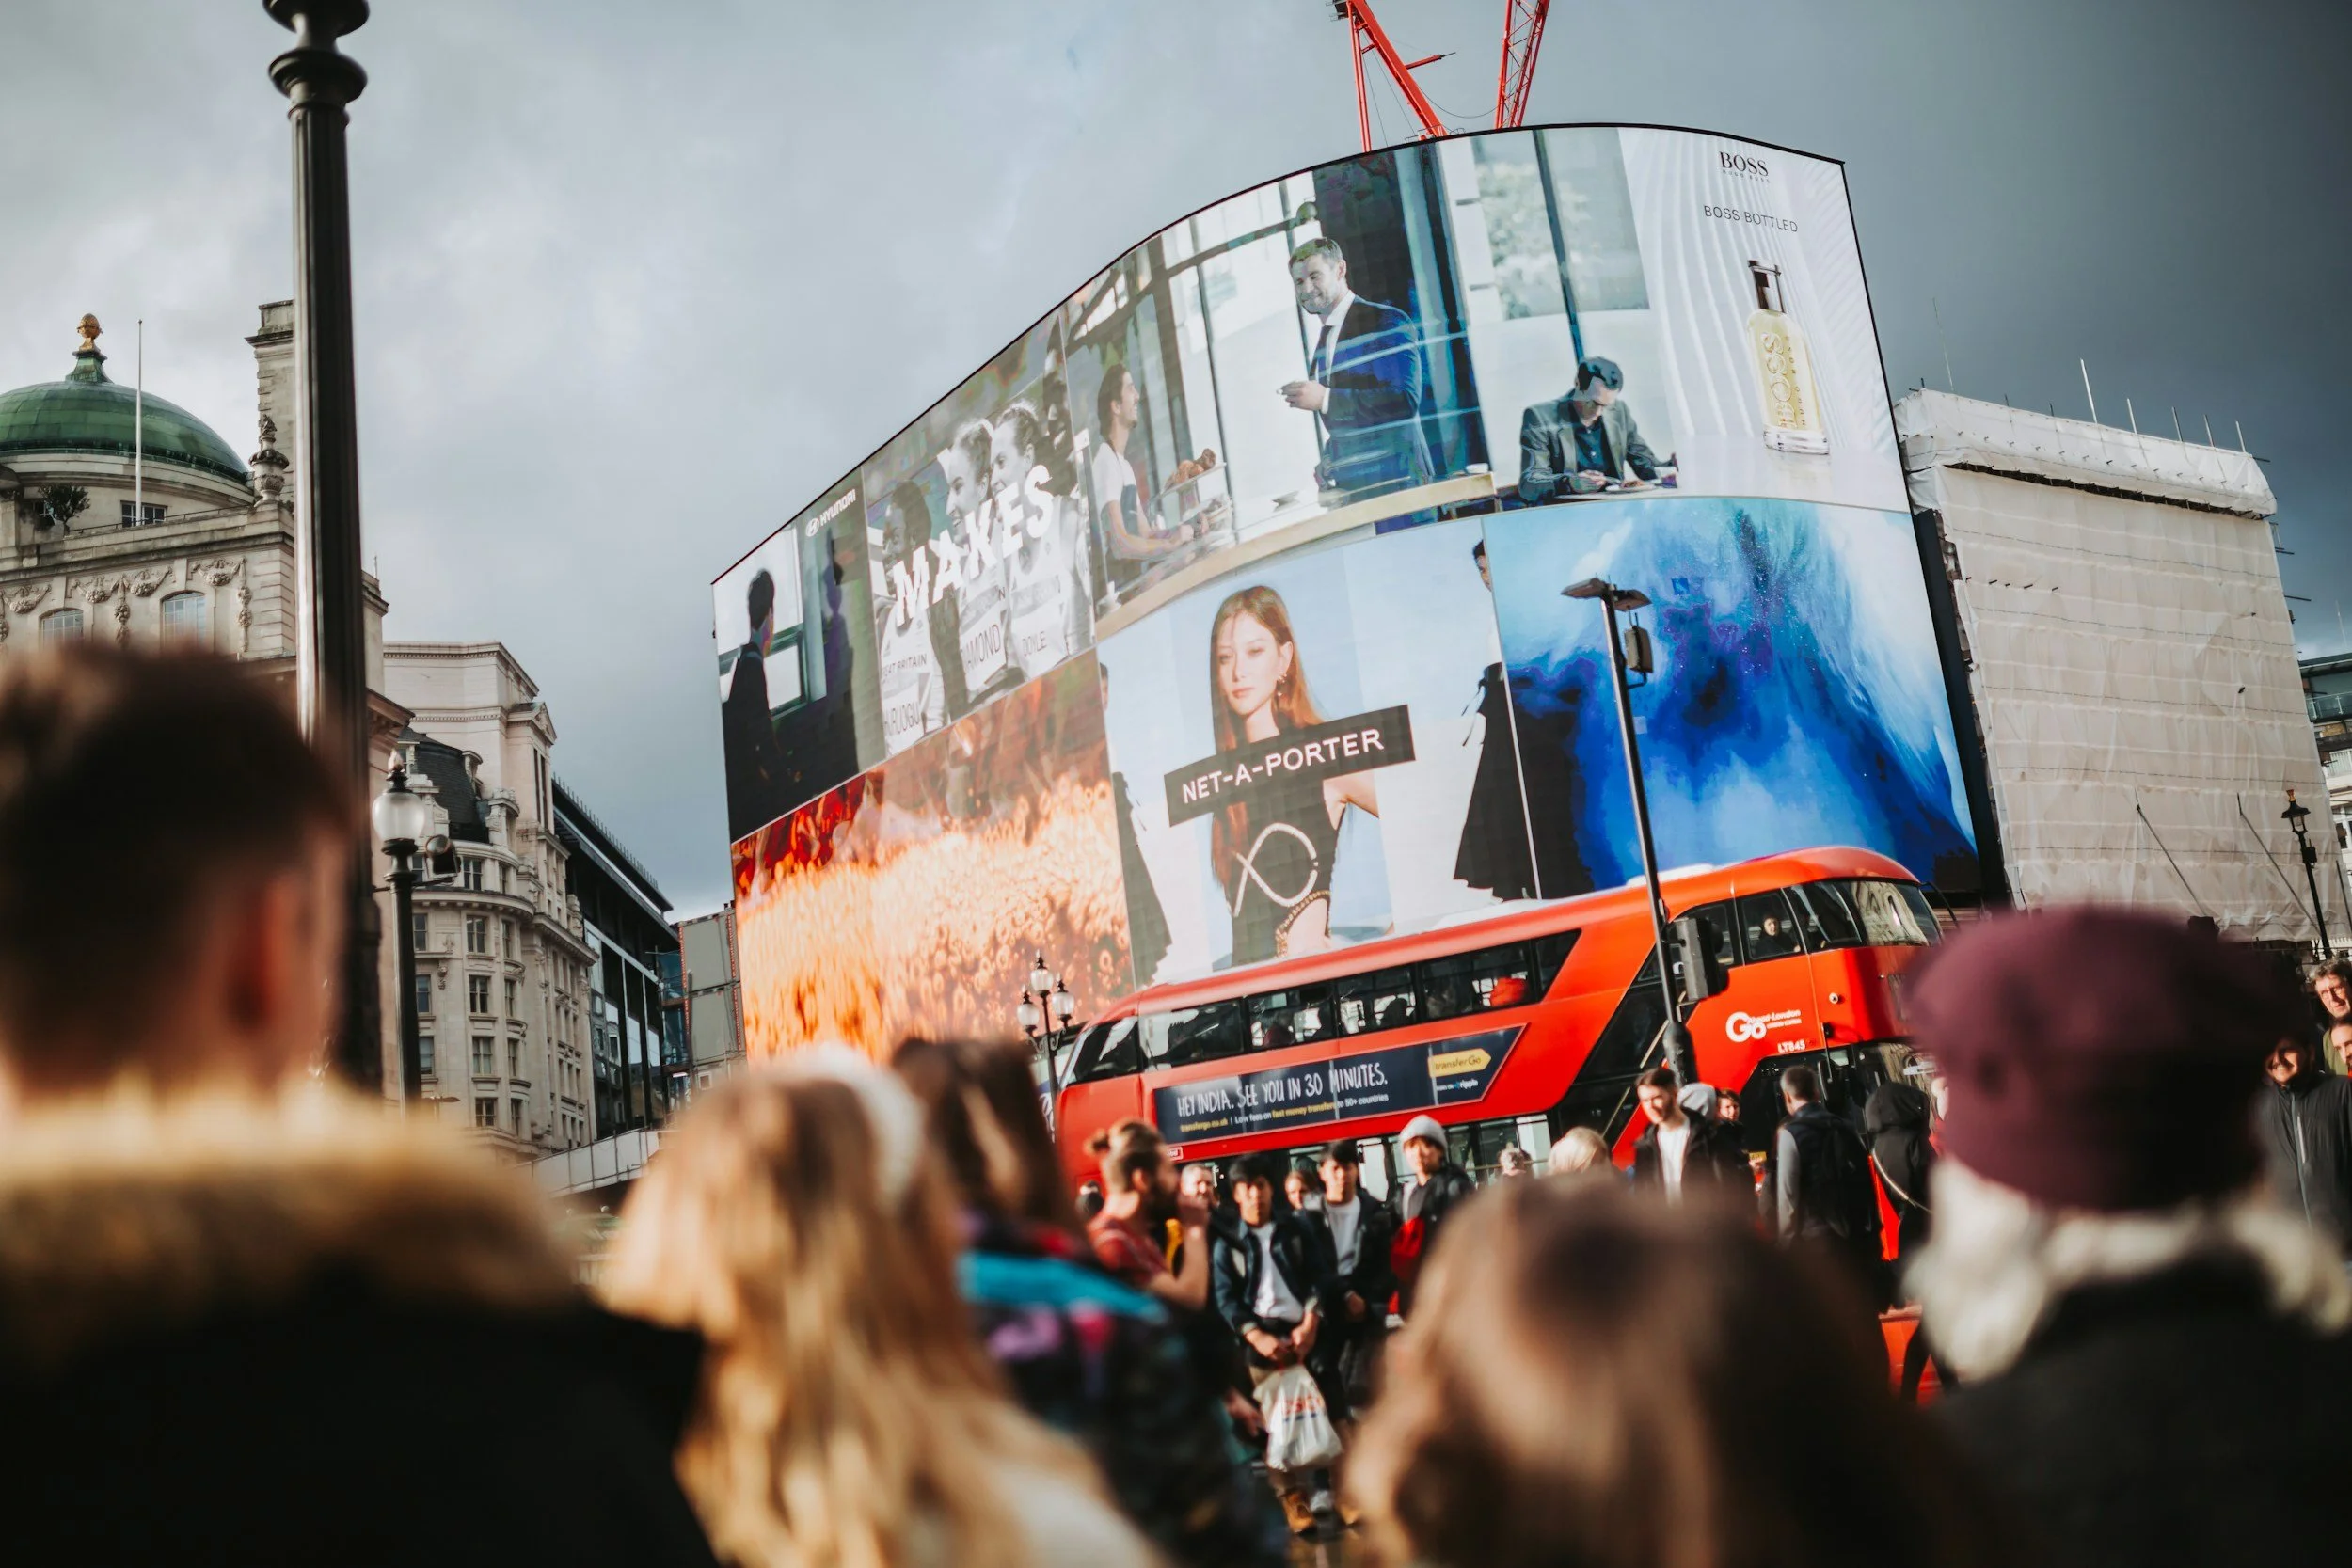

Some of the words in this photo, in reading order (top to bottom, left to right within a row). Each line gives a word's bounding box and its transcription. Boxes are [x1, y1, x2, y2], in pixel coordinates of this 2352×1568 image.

[1720, 151, 1769, 177] BOSS
[1704, 205, 1740, 221] BOSS
[1744, 212, 1798, 232] BOTTLED
[819, 488, 856, 526] HYUNDAI
[893, 465, 1054, 627] MAKES
[1182, 728, 1385, 804] NET-A-PORTER
[1725, 1011, 1767, 1043] Go
[1177, 1094, 1195, 1117] HEY
[1198, 1088, 1234, 1115] INDIA.
[1237, 1084, 1259, 1108] SEE
[1262, 1079, 1285, 1104] YOU
[1287, 1077, 1301, 1100] IN
[1304, 1072, 1324, 1097] 30
[1328, 1062, 1388, 1093] MINUTES.
[1359, 1093, 1390, 1106] countries
